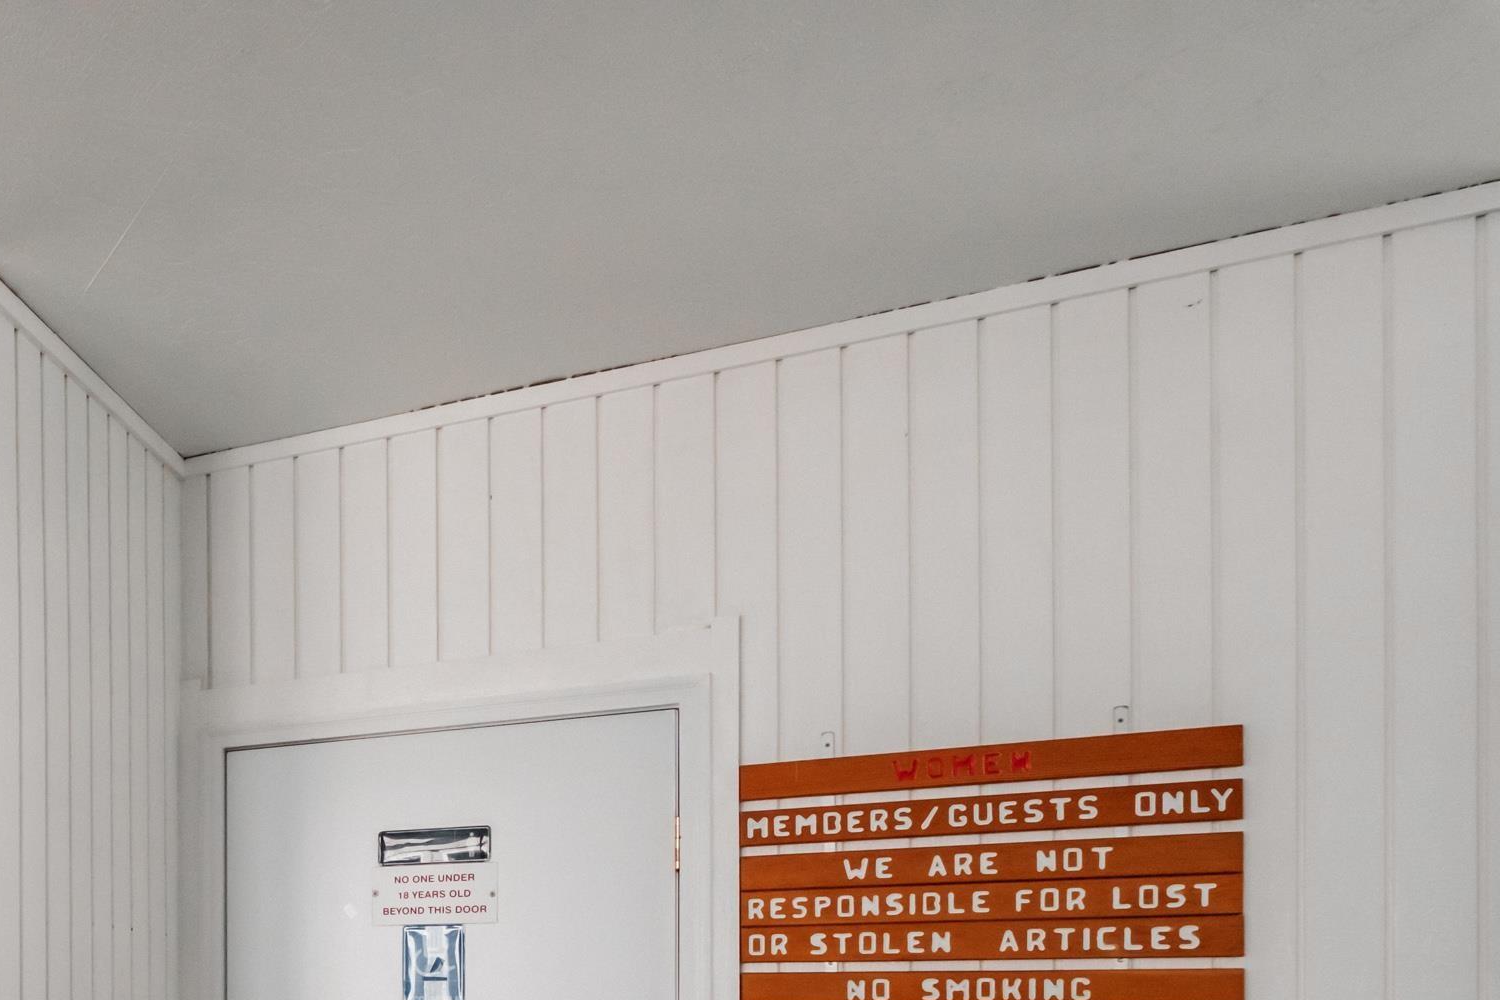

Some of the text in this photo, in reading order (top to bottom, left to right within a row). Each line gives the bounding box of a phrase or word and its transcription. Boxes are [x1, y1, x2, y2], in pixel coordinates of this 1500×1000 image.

[892, 751, 1032, 781] WOMEN
[747, 787, 1233, 839] MEMBERS/GUESTS ONLY
[843, 846, 1114, 880] WE ARE NOT
[394, 873, 475, 884] NO ONE UNDER
[398, 889, 471, 899] 18 YEARS OLD
[748, 883, 1217, 919] RESPONSIBLE FOR LOST
[383, 904, 487, 916] BEYOND THIS DOOR
[748, 925, 1201, 956] OR STOLEN ARTICLES
[847, 977, 1091, 1000] NO SMOKING
